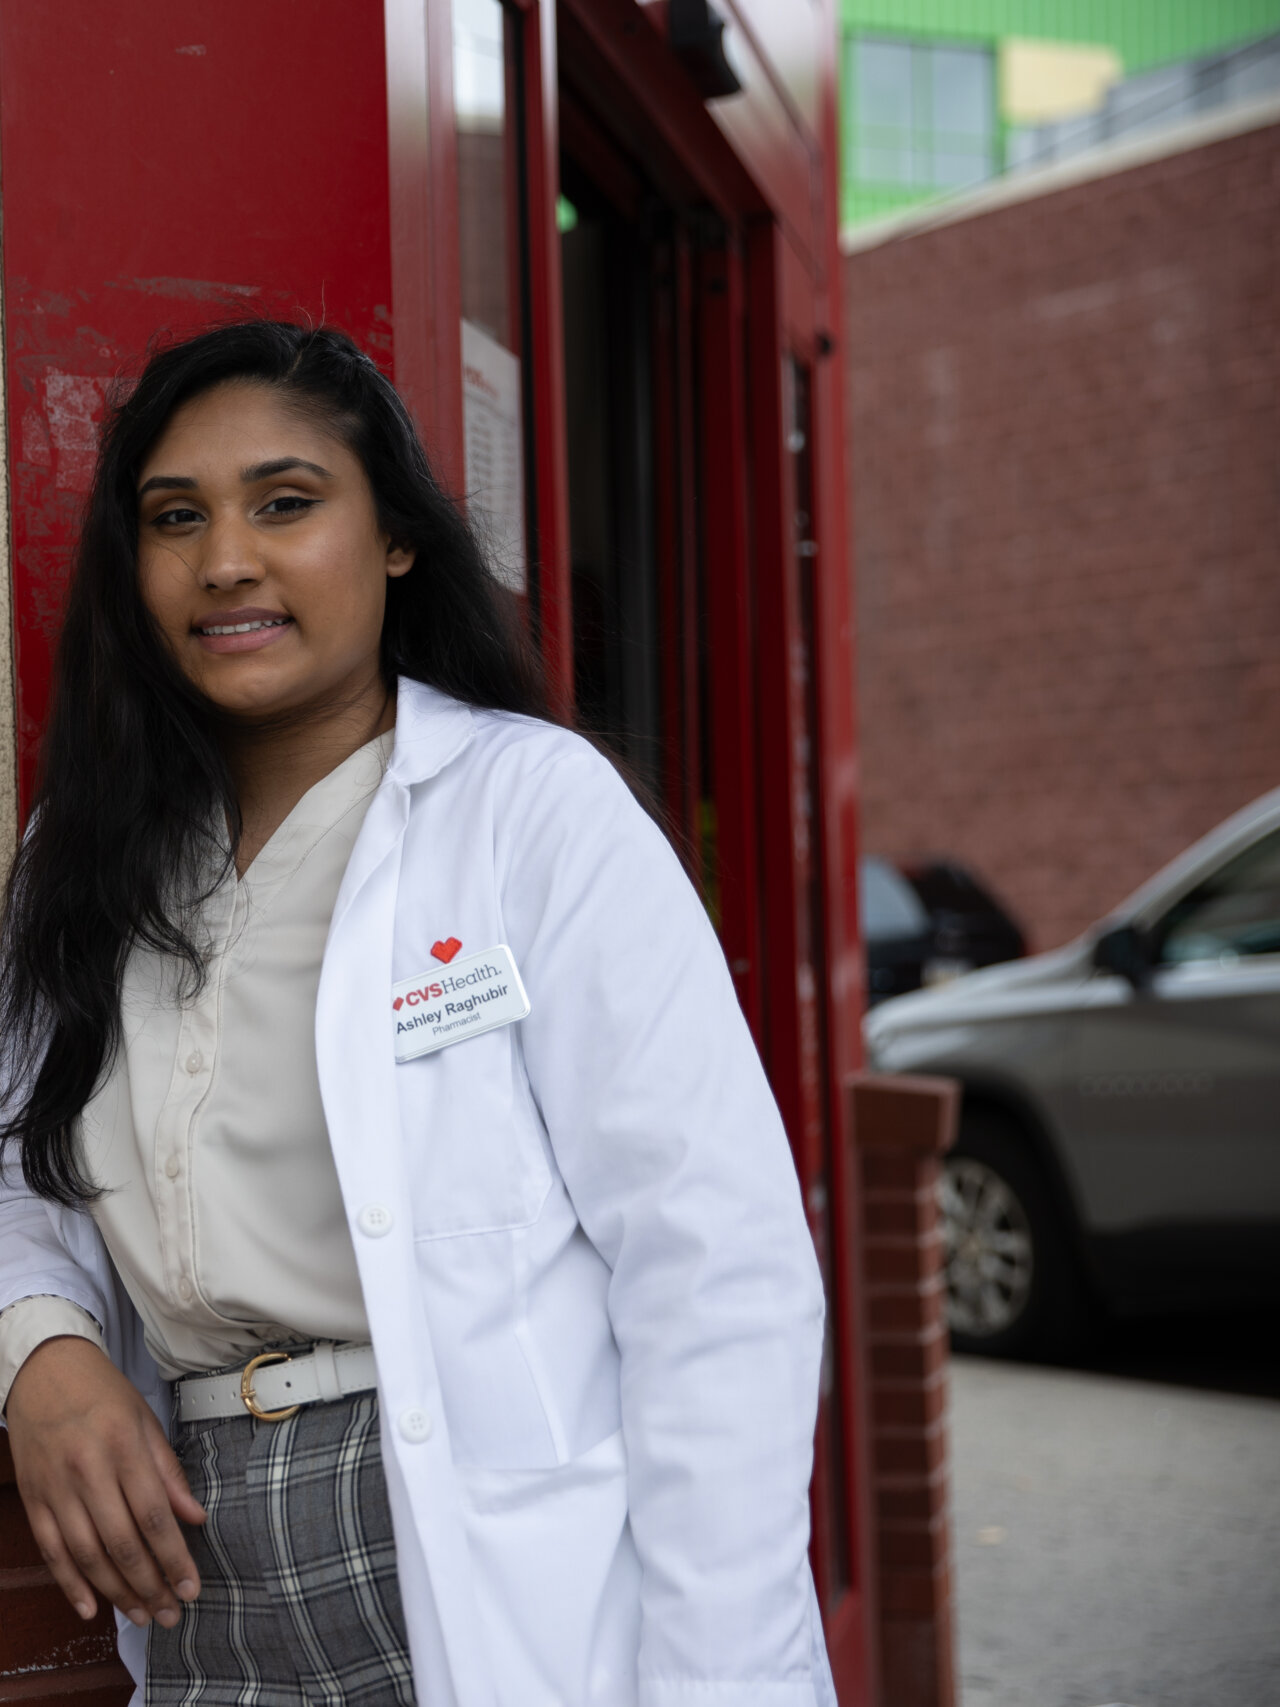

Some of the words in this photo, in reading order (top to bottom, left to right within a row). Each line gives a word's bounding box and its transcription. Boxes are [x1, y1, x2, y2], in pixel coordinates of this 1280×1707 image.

[396, 1010, 442, 1034] Ashley
[444, 984, 508, 1016] Raghubir
[432, 1012, 482, 1036] Pharmacist
